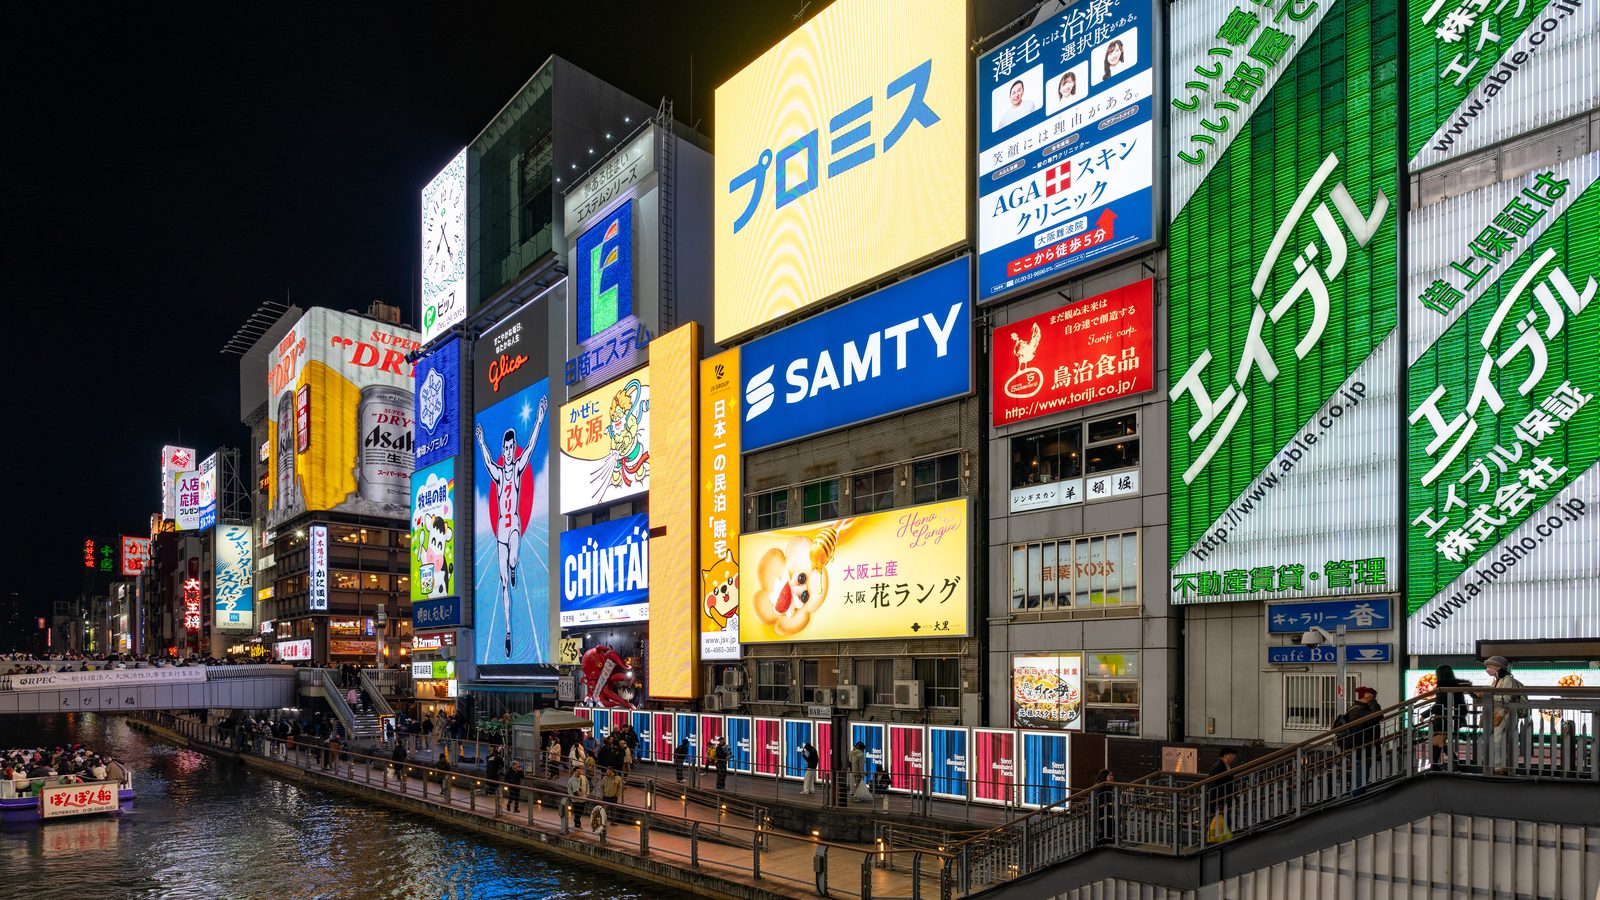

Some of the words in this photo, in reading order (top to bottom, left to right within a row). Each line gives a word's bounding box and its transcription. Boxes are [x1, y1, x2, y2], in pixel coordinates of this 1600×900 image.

[1060, 13, 1137, 64] 選択肢がある。
[729, 58, 941, 235] プロミス
[993, 89, 1139, 166] 笑顔には理由がある。
[577, 164, 638, 223] エステムシリーズ
[583, 153, 630, 198] 夢ある住まい
[992, 180, 1042, 217] AGA
[1075, 138, 1138, 182] スキン
[1017, 180, 1108, 235] クリニック
[1013, 228, 1107, 272] ここから徒歩5分
[1037, 220, 1085, 246] 大阪難波院
[1418, 170, 1571, 317] 借上保証は
[437, 290, 456, 318] ビップ
[1049, 299, 1107, 325] まだ観ぬ未来は
[1064, 305, 1136, 336] 自分達で創造する
[1168, 152, 1390, 486] エイブル
[371, 331, 421, 351] SUPER
[565, 322, 651, 386] 日商エステム
[786, 302, 963, 404] SAMTY
[489, 354, 530, 393] Glico
[1051, 346, 1140, 390] 鳥治食品
[1408, 247, 1598, 487] エイブル
[384, 408, 406, 417] SUPER
[569, 400, 600, 424] かぜに
[1005, 376, 1137, 420] http://www.toriji.co.jp/
[364, 424, 415, 454] Asah
[567, 415, 603, 453] 改源
[387, 453, 402, 465] 生
[1191, 380, 1367, 562] http://www.able.co.jp
[1411, 380, 1595, 539] エイブル保証
[180, 478, 199, 492] 入店
[180, 492, 199, 507] 応援
[418, 484, 447, 510] 牧場の朝
[504, 481, 512, 528] グリコ
[1013, 491, 1056, 504] ジンギスカン
[180, 507, 199, 516] プレゼン
[1436, 456, 1569, 562] 株式会社
[224, 527, 252, 587] シャッターは
[564, 529, 649, 601] CHINTAI
[843, 561, 898, 581] 大阪土産
[1173, 556, 1386, 599] 不動産賃貸・管理
[1421, 494, 1587, 630] www.a-hosho.co.jp
[843, 591, 866, 605] 大阪
[870, 576, 961, 608] 花ラング
[1272, 611, 1338, 626] ギャラリー
[1343, 603, 1385, 626] 香
[705, 636, 737, 645] www.jsv.jp
[1273, 650, 1304, 662] café
[1310, 648, 1337, 662] Bo
[50, 788, 112, 808] ぽんぽん船
